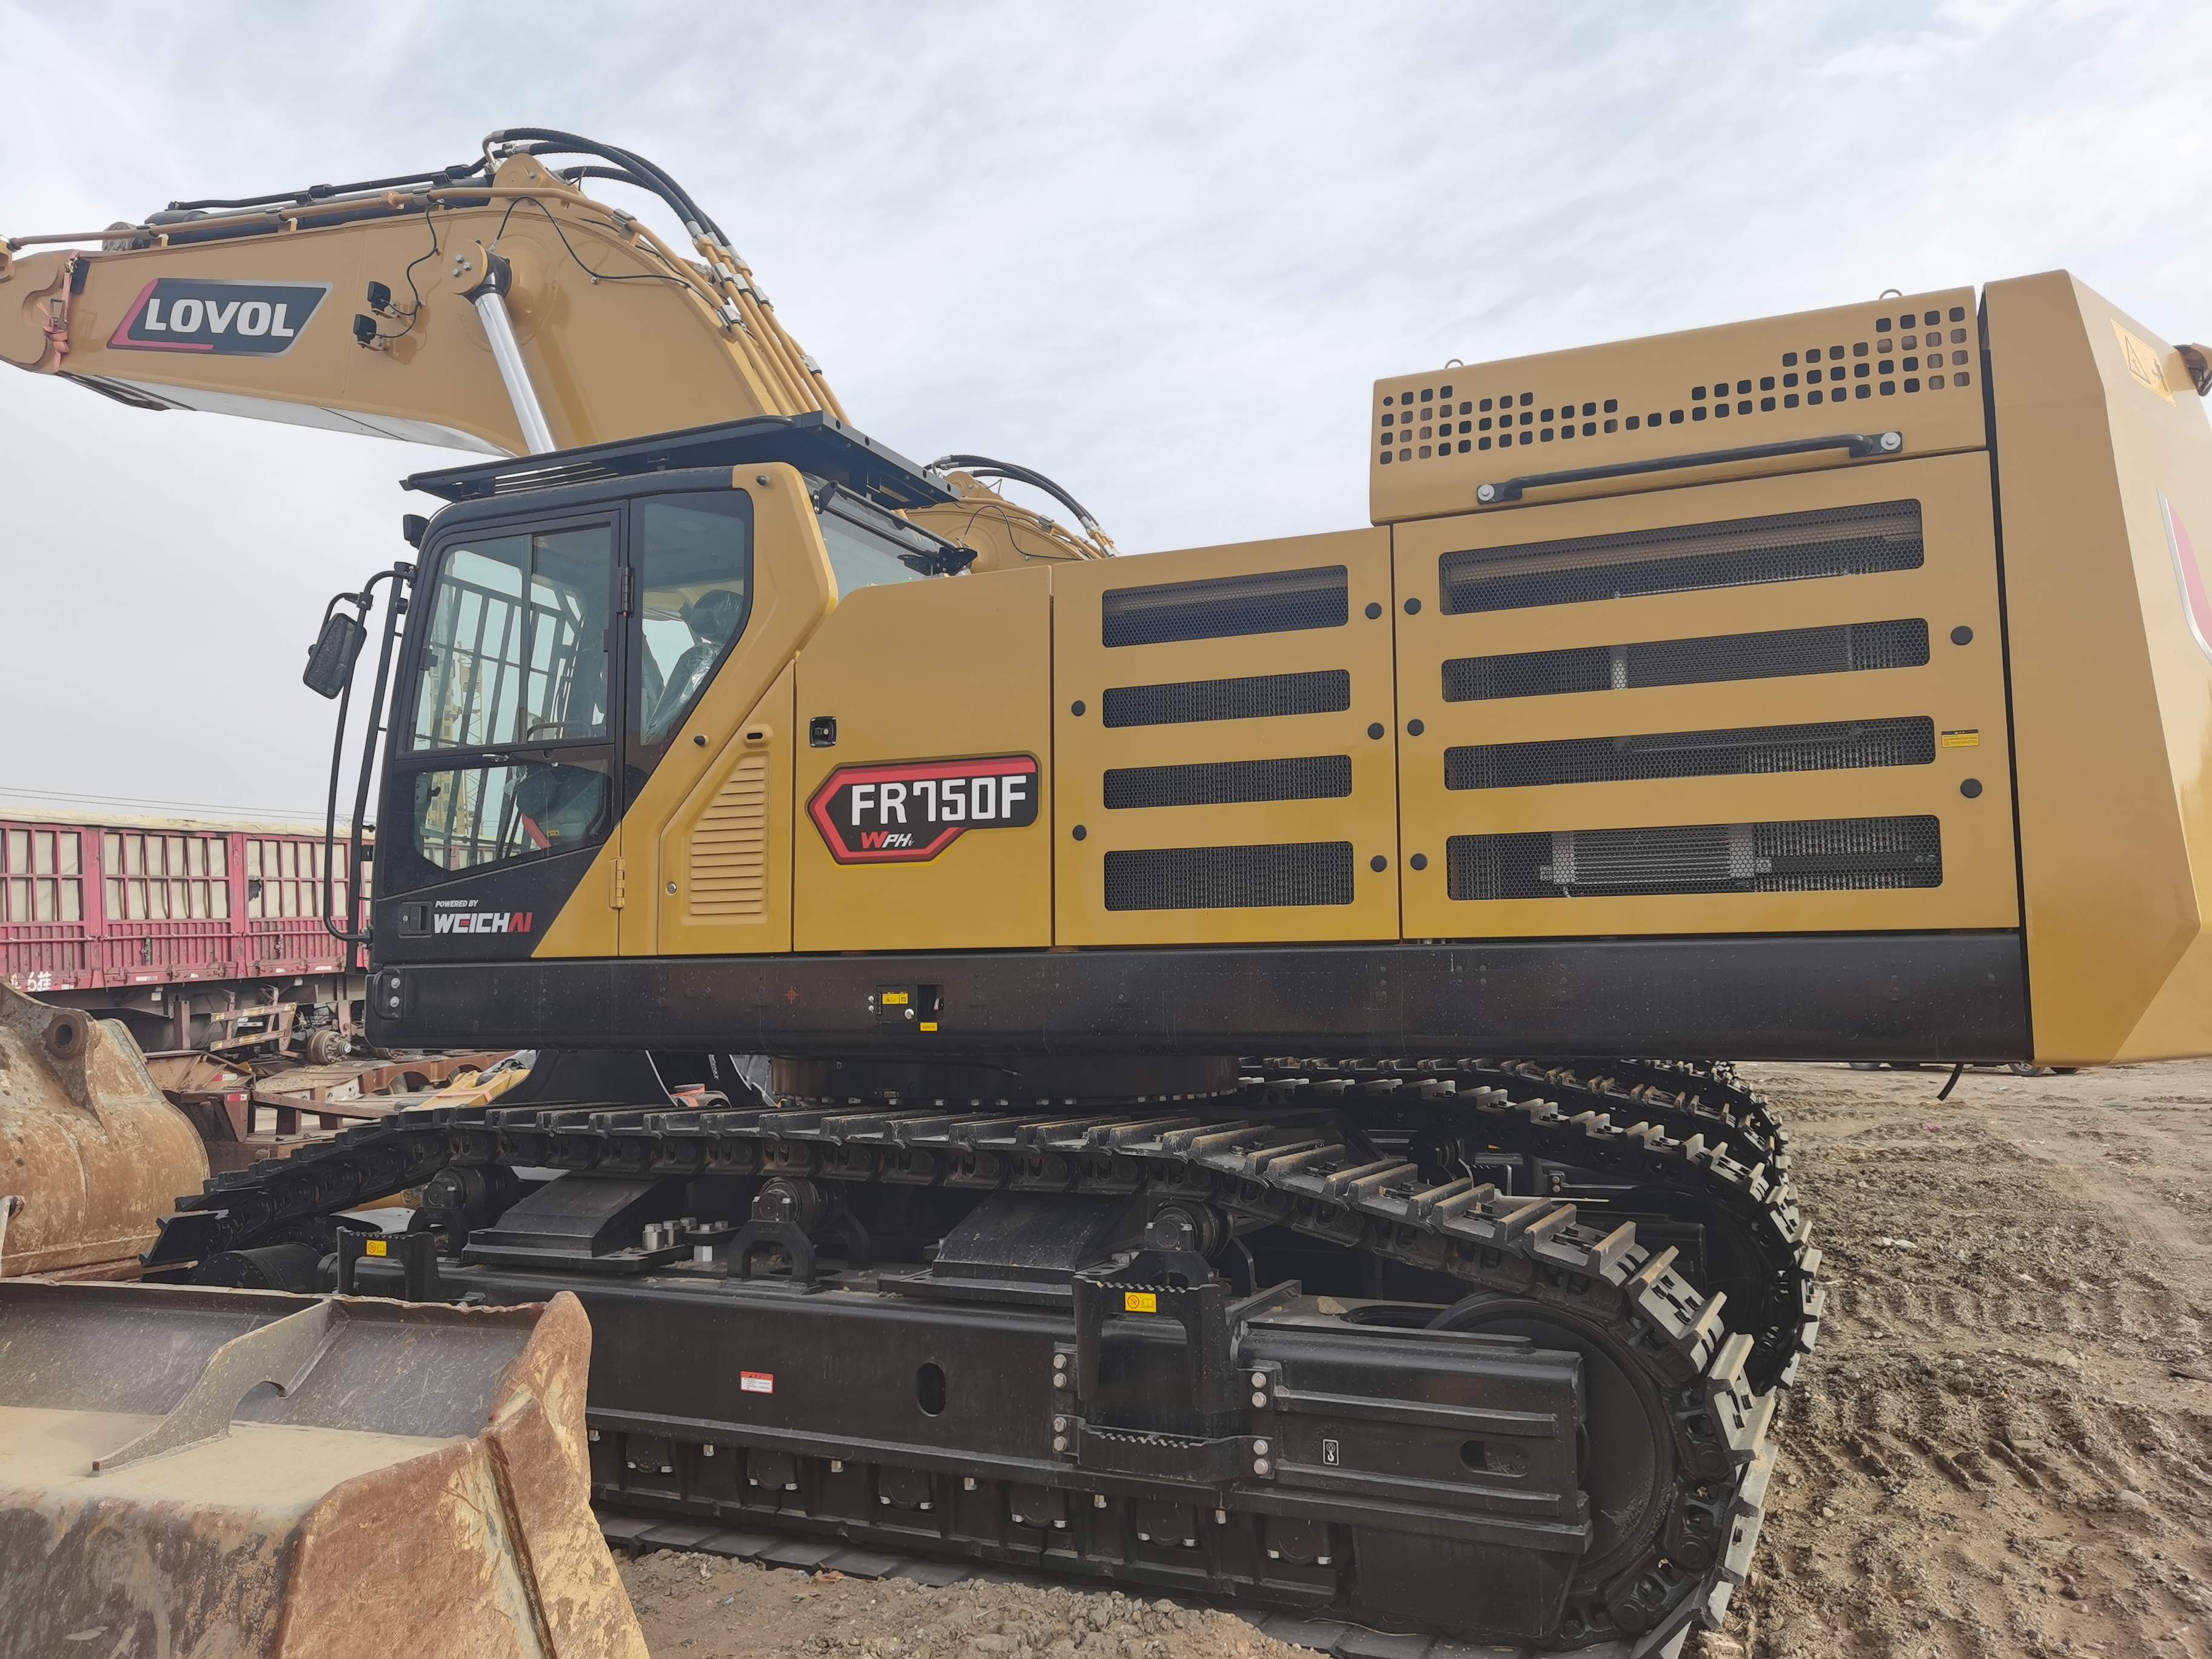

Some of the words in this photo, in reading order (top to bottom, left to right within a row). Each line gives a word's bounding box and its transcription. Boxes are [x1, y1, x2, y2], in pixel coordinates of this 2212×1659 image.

[144, 298, 294, 337] LOVOL
[851, 775, 1027, 826] FR750F
[434, 911, 533, 933] WEICHAI
